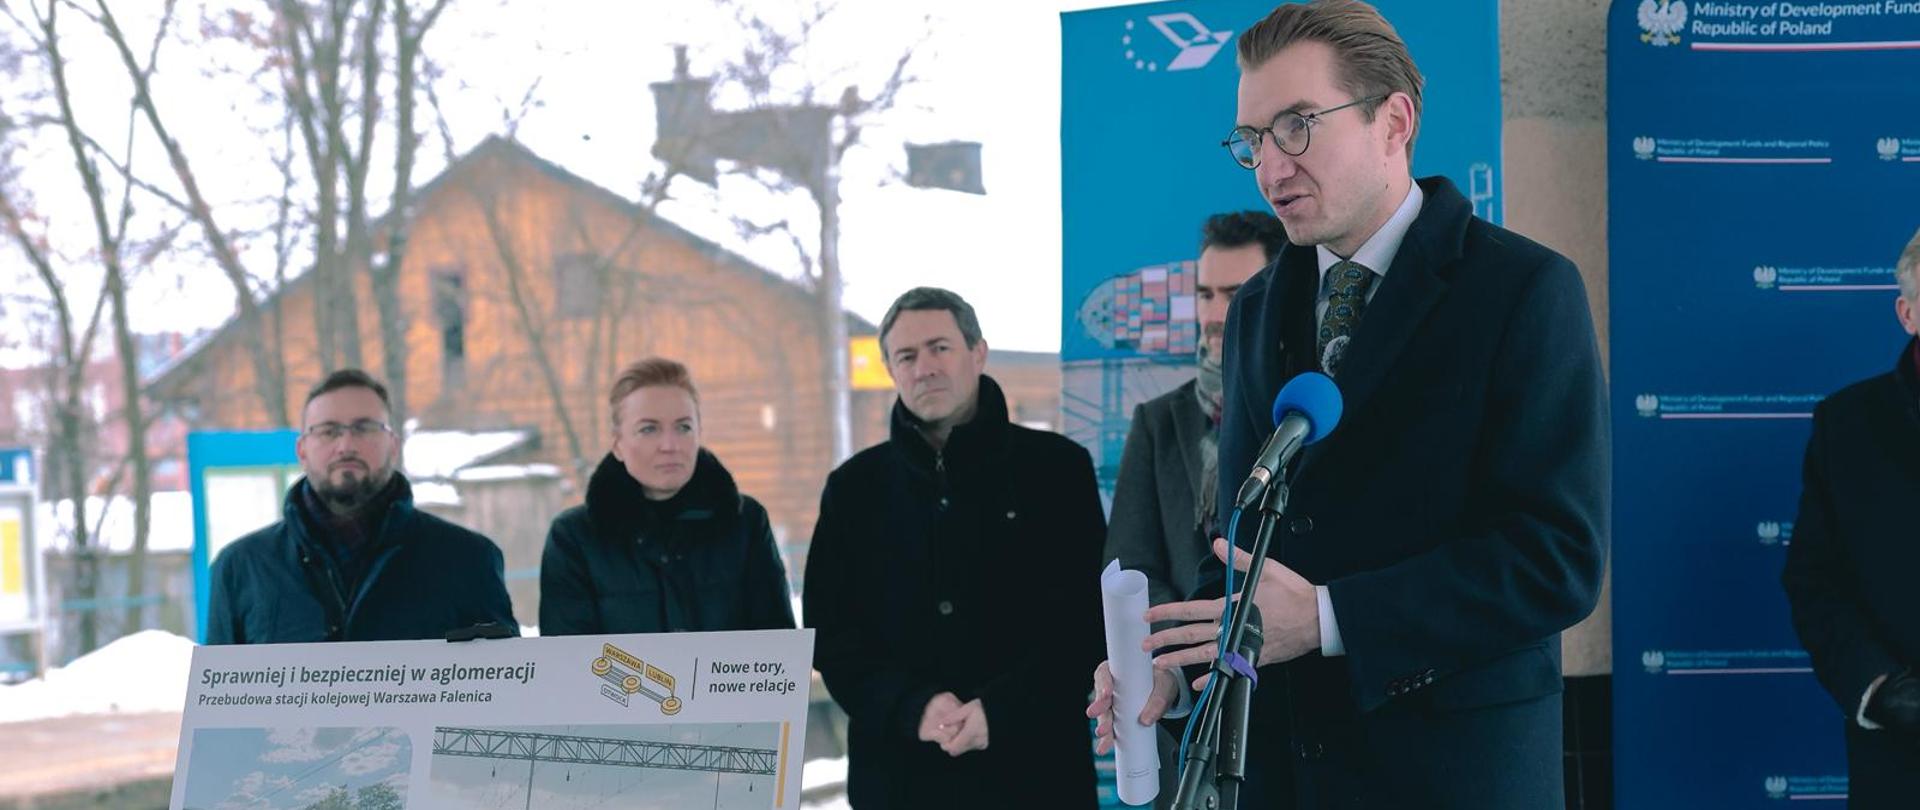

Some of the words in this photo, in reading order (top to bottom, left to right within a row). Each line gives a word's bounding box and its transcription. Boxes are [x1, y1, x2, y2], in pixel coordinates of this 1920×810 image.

[1694, 2, 1759, 19] Ministry
[1760, 2, 1778, 17] of
[1780, 2, 1881, 18] Development
[1692, 20, 1758, 37] Republic
[1760, 20, 1777, 35] of
[1780, 20, 1832, 35] Poland
[606, 647, 641, 669] WARSZAWA
[201, 667, 286, 688] Sprawniej
[290, 666, 296, 683] i
[300, 664, 406, 687] bezpieczniej
[411, 668, 426, 681] w
[430, 662, 536, 685] aglomeracji
[711, 661, 750, 674] Nowe
[754, 661, 785, 676] tory,
[709, 682, 746, 693] nowe
[749, 678, 796, 695] relacje
[198, 693, 272, 706] Przebudowa
[275, 692, 308, 708] stacji
[311, 691, 371, 708] kolejowej
[373, 691, 437, 704] Warszawa
[440, 689, 492, 703] Falenica
